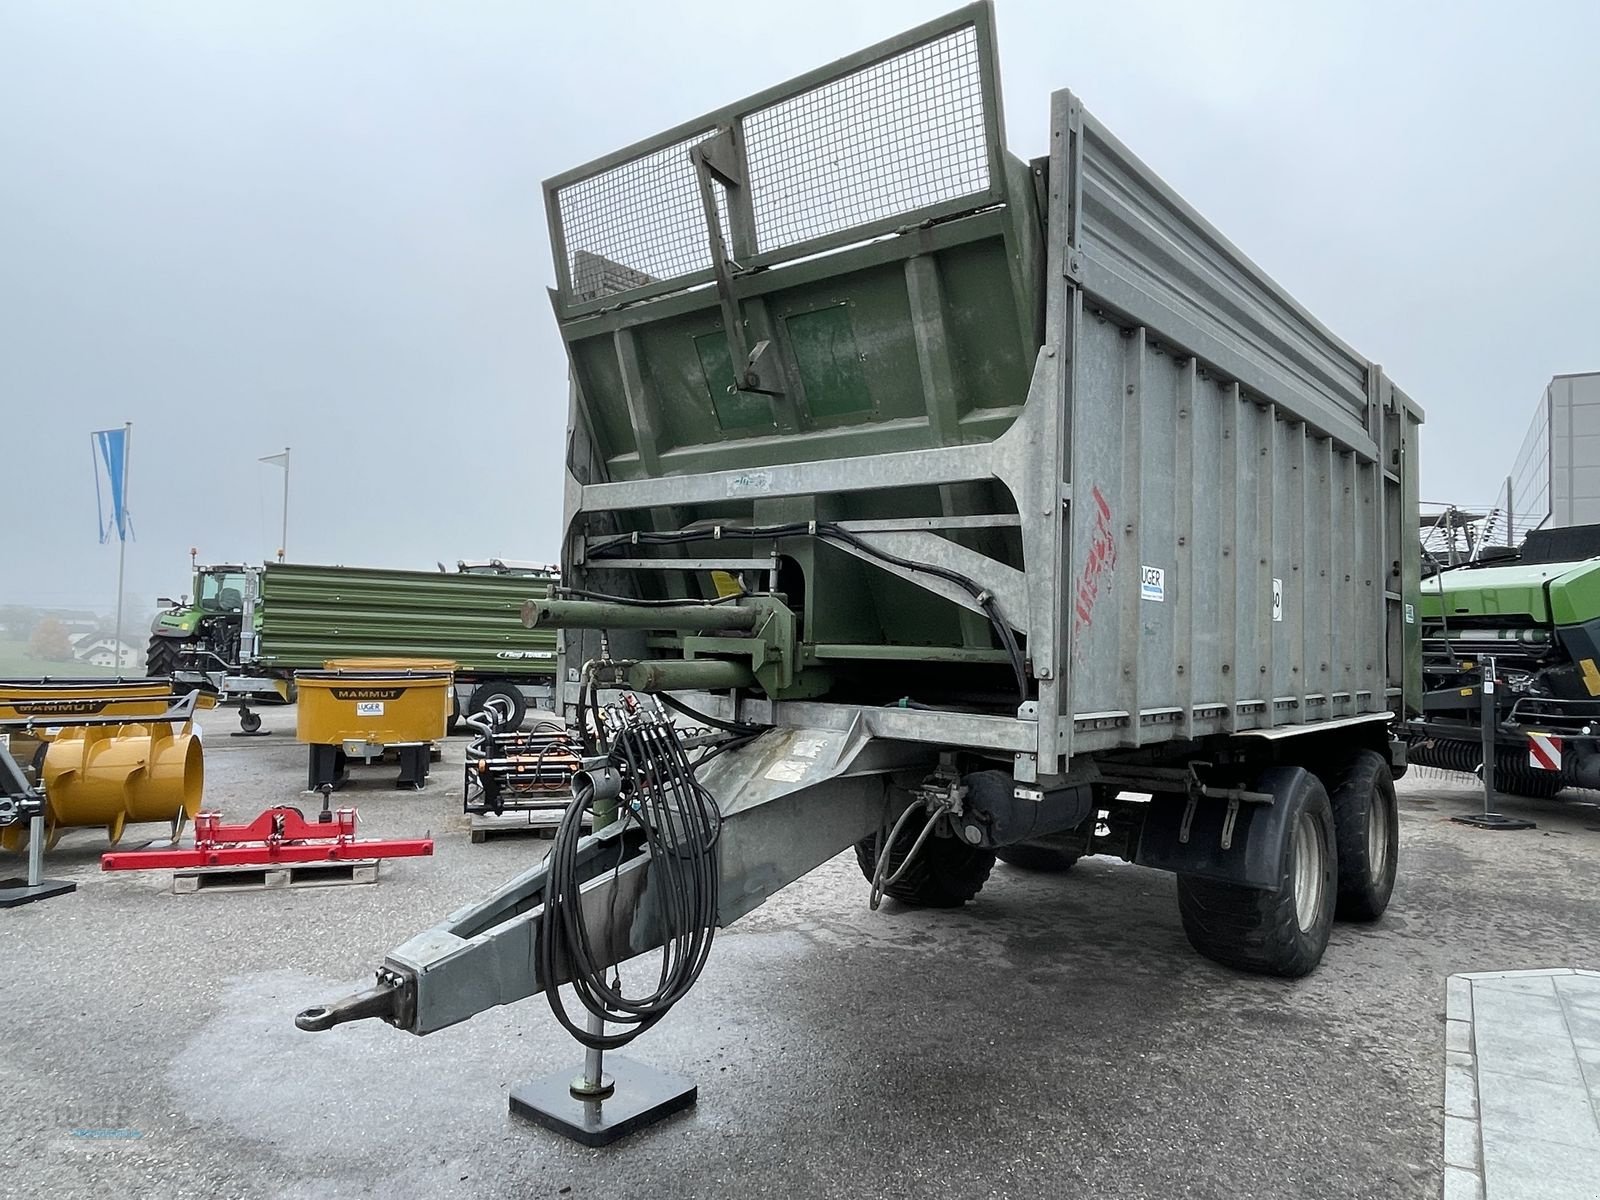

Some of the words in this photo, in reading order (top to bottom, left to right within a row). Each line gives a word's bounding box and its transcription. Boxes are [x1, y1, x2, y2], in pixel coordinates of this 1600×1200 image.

[1141, 568, 1161, 586] UGER
[338, 690, 397, 698] MAMMUT
[19, 703, 97, 711] MAMMUT
